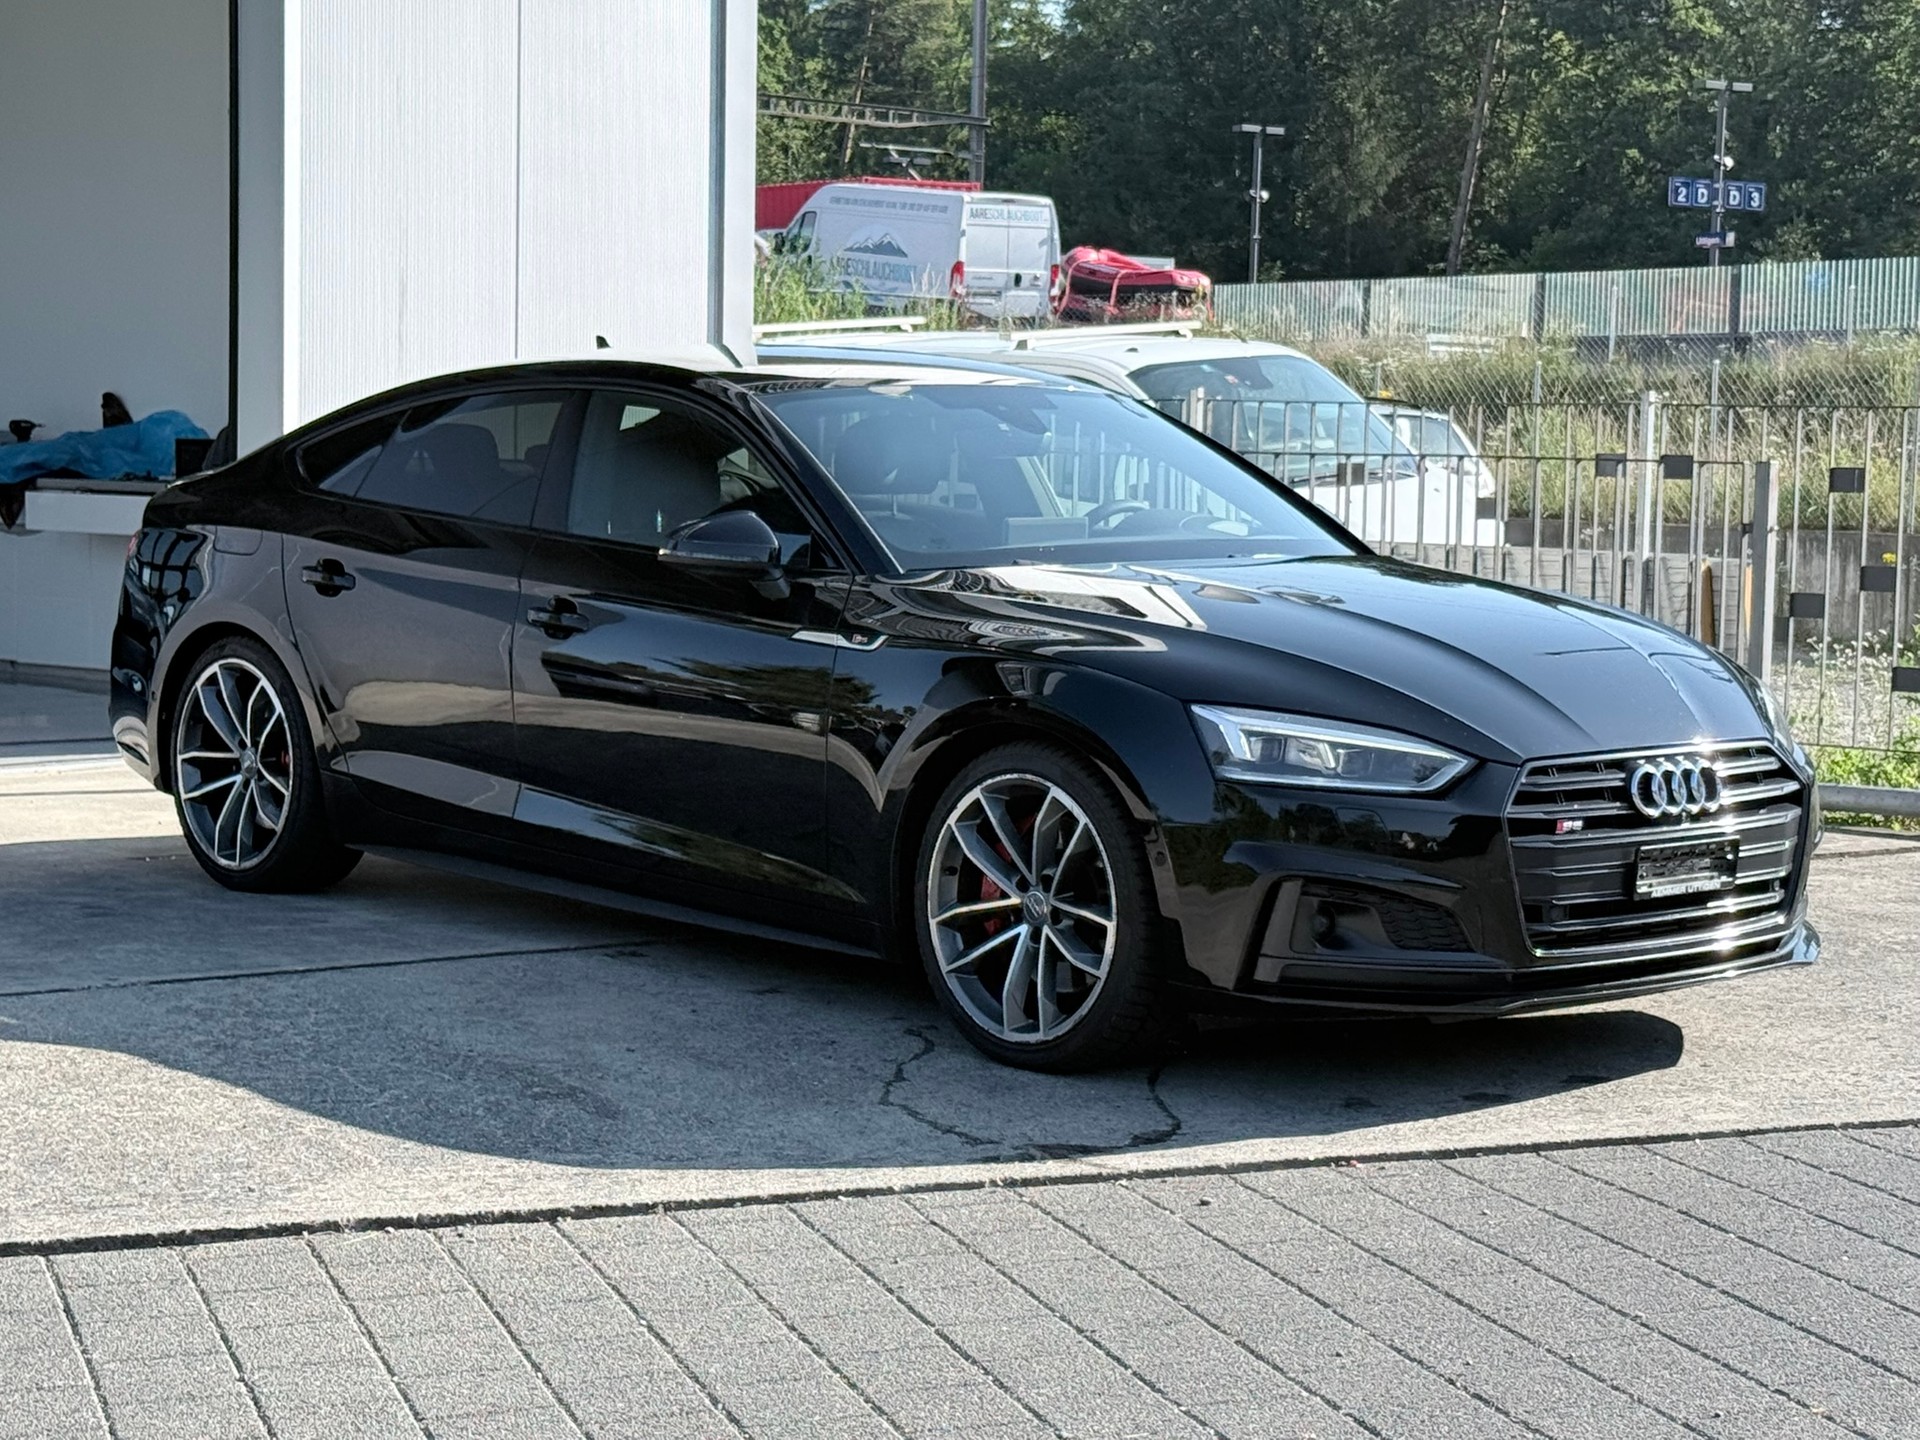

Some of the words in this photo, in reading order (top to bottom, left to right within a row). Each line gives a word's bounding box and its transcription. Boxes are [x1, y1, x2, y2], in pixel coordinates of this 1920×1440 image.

[1677, 187, 1687, 202] 2
[1697, 188, 1708, 204] D
[1729, 190, 1740, 206] D
[1750, 192, 1760, 207] 3
